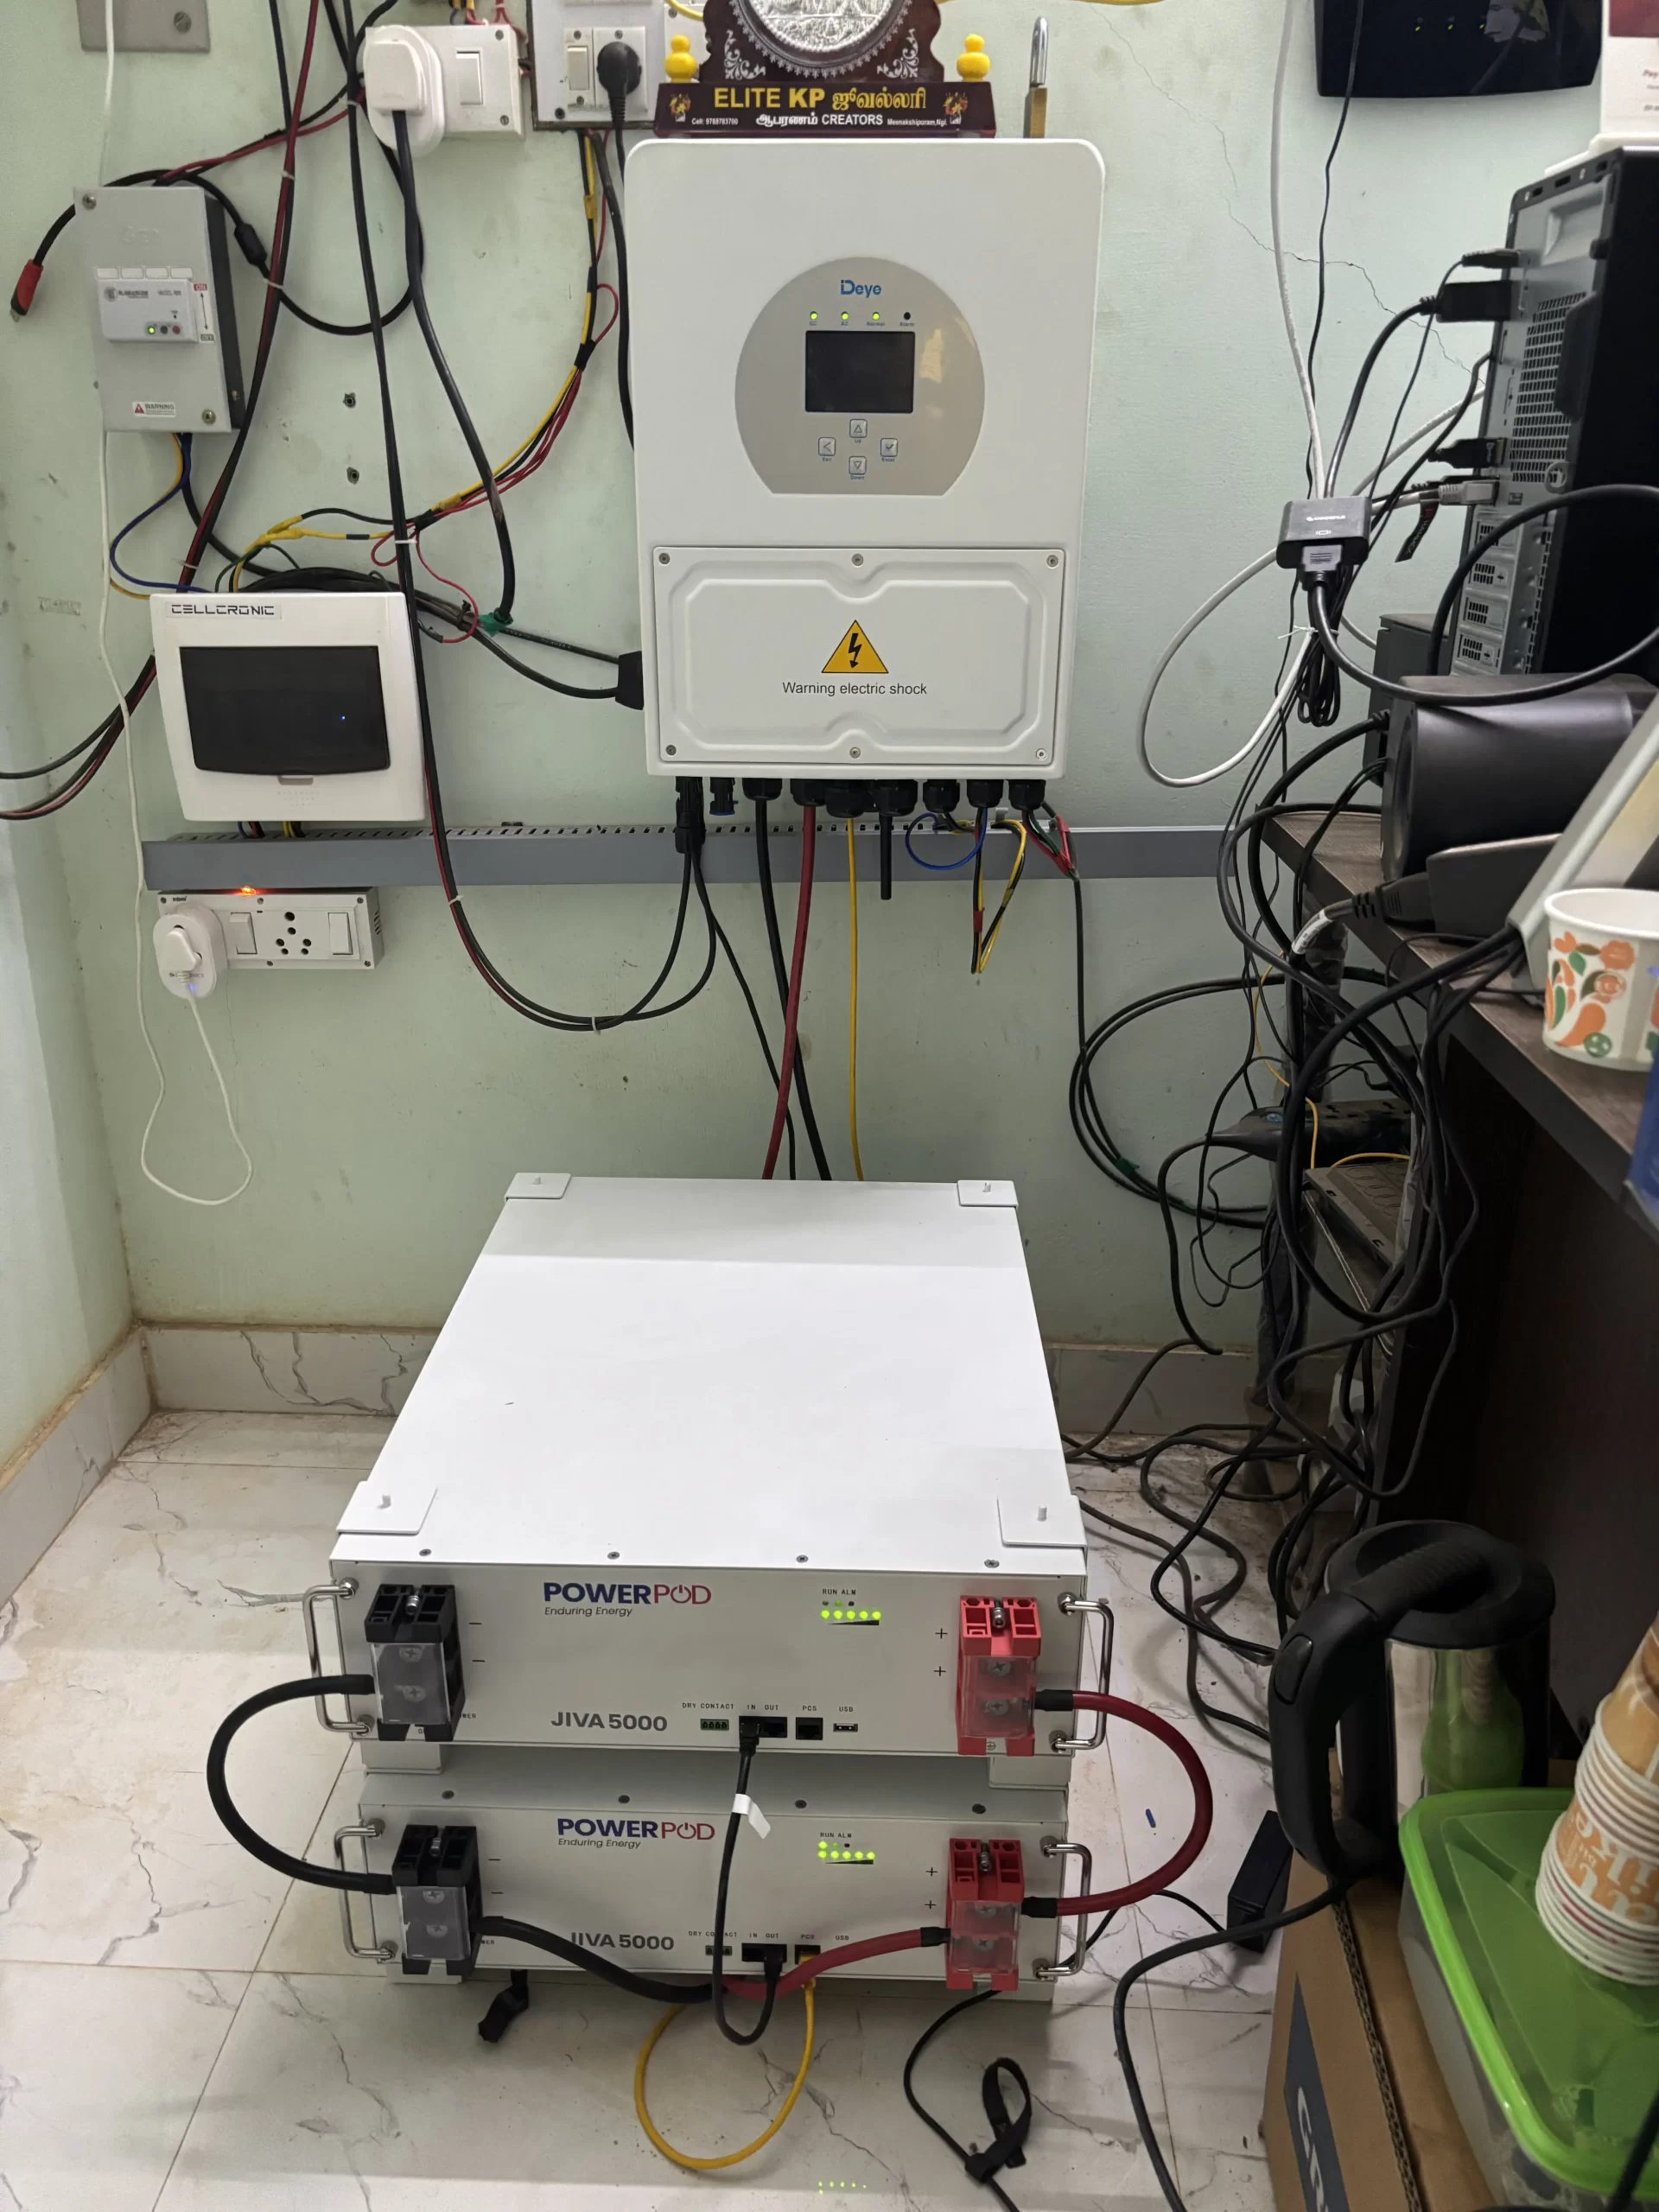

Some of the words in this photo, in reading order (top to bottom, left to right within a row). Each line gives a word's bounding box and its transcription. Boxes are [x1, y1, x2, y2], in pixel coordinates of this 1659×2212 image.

[715, 87, 781, 108] ELITE
[789, 87, 825, 108] KP
[822, 114, 883, 125] CREATORS
[840, 279, 882, 298] Deye
[782, 682, 836, 696] Warning
[840, 683, 886, 695] electric
[889, 683, 927, 695] shock
[544, 1607, 593, 1617] Enduring
[595, 1607, 633, 1618] Energy
[550, 1712, 606, 1729] JIVA
[608, 1713, 668, 1732] 5000
[558, 1838, 603, 1848] Enduring
[606, 1839, 641, 1849] Energy
[619, 1934, 674, 1950] 5000
[1297, 2086, 1329, 2212] GR
